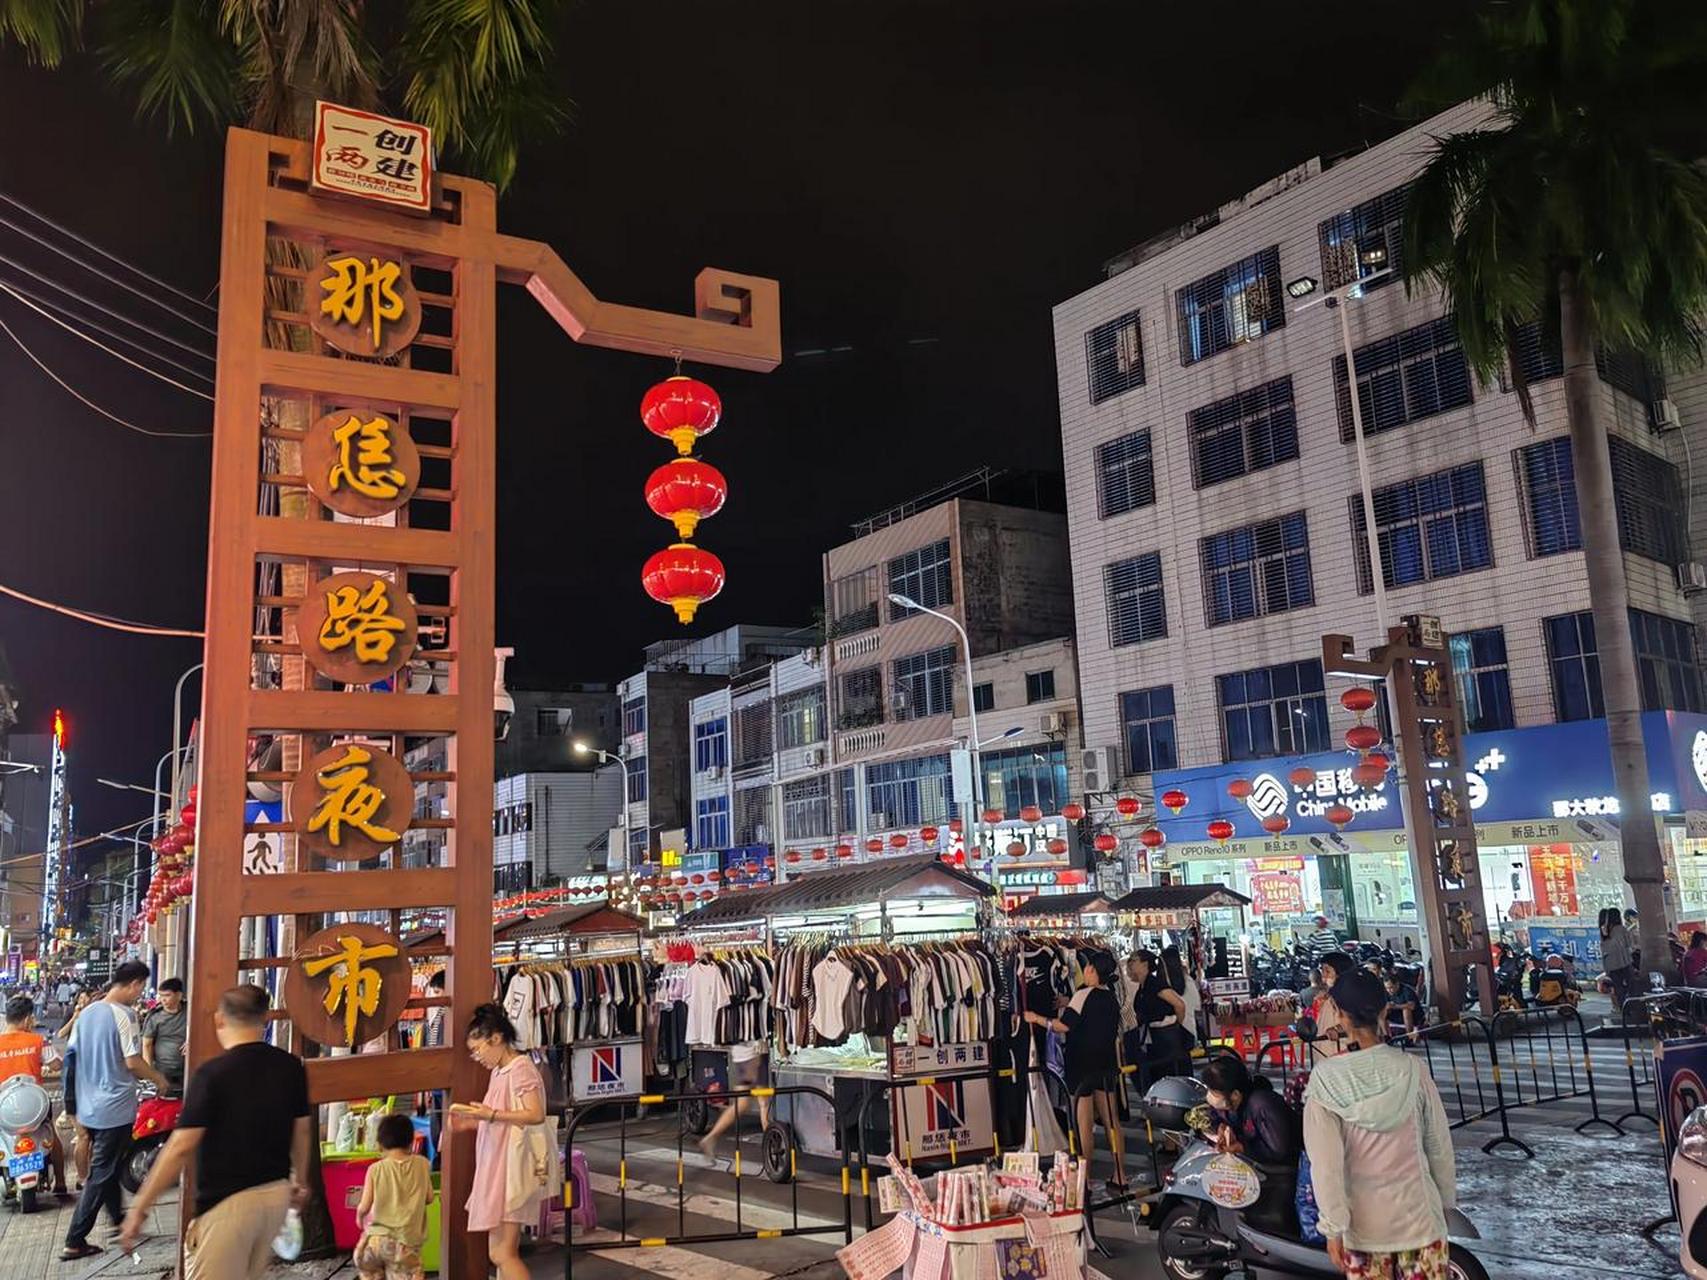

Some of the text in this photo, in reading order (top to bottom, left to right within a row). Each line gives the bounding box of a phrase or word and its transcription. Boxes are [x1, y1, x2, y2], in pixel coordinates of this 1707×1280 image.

[332, 125, 418, 155] 一创
[326, 144, 418, 181] 两建
[1294, 767, 1385, 799] 国移
[1511, 824, 1559, 839] 新品上市
[1181, 847, 1203, 857] OPPO
